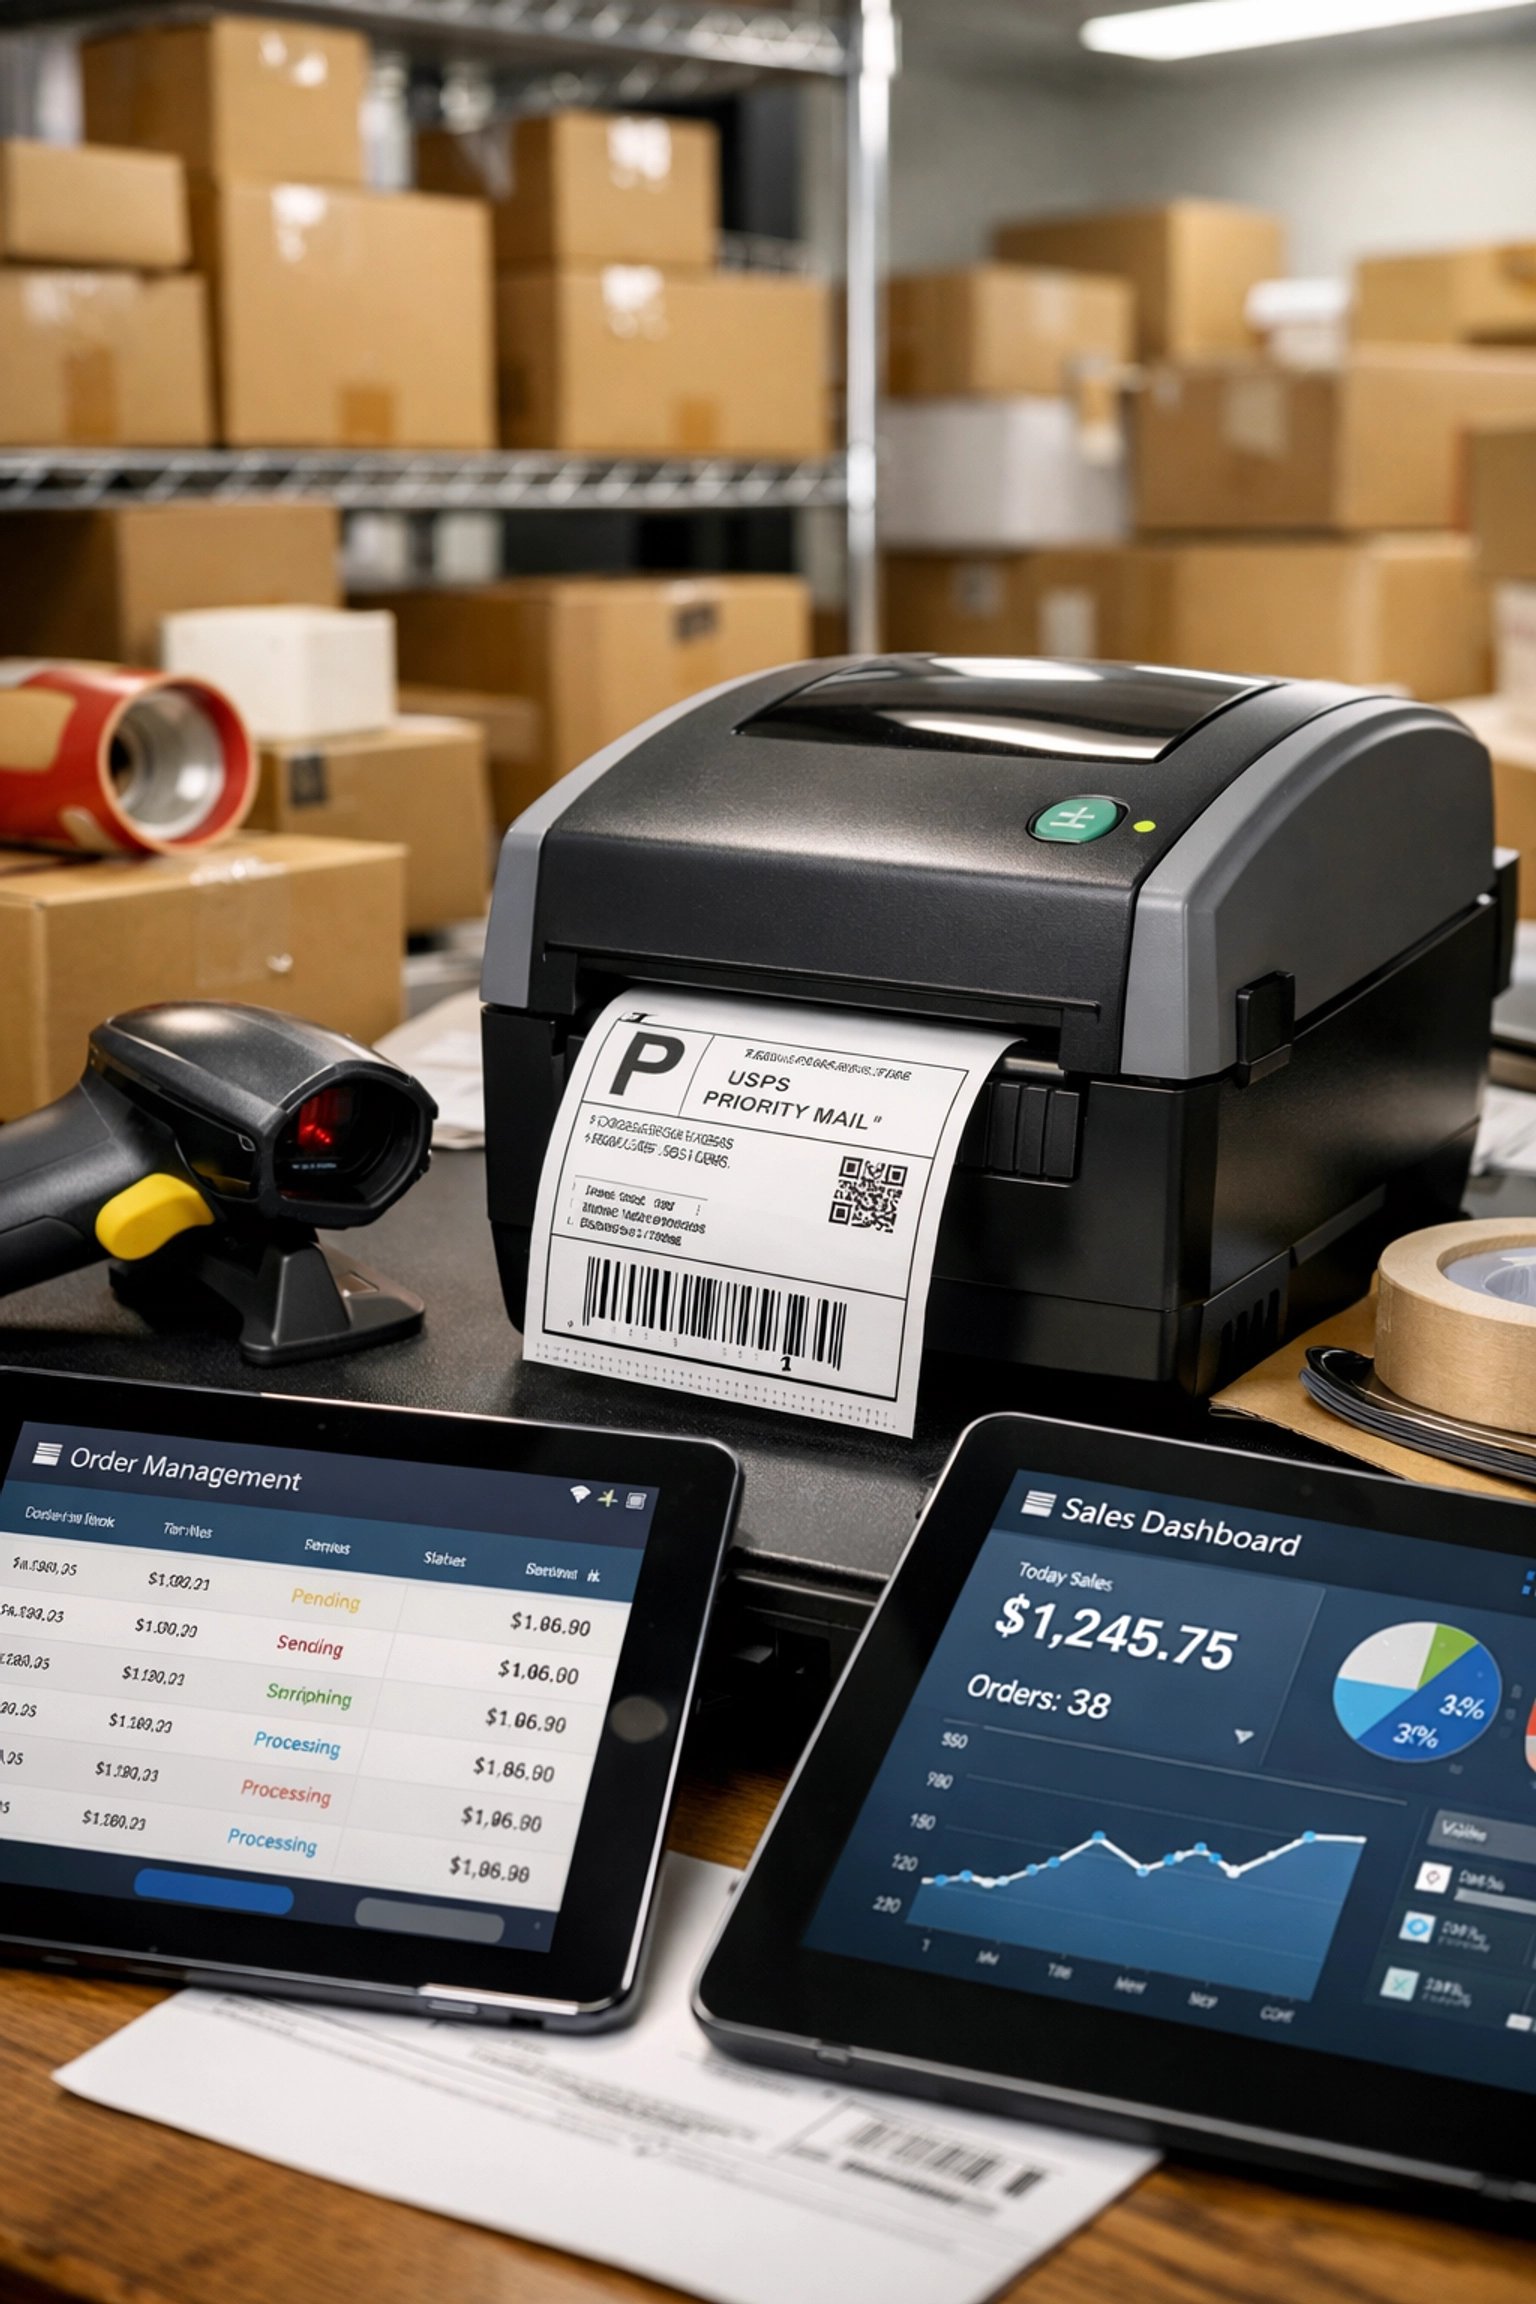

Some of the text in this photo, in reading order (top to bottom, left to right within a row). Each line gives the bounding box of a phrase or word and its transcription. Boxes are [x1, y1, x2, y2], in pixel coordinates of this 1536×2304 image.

[609, 1031, 685, 1096] P
[728, 1070, 790, 1092] USPS
[703, 1090, 810, 1120] PRIORITY
[69, 1447, 302, 1492] Order Management
[1061, 1498, 1303, 1557] Sales Dashboard
[1019, 1562, 1114, 1593] Today Sales
[291, 1588, 361, 1614] Pending
[277, 1635, 344, 1660] Sending
[994, 1593, 1239, 1672] $1,245.75
[967, 1673, 1112, 1720] Orders: 38
[240, 1779, 332, 1809] Processing
[227, 1828, 318, 1858] Processing
